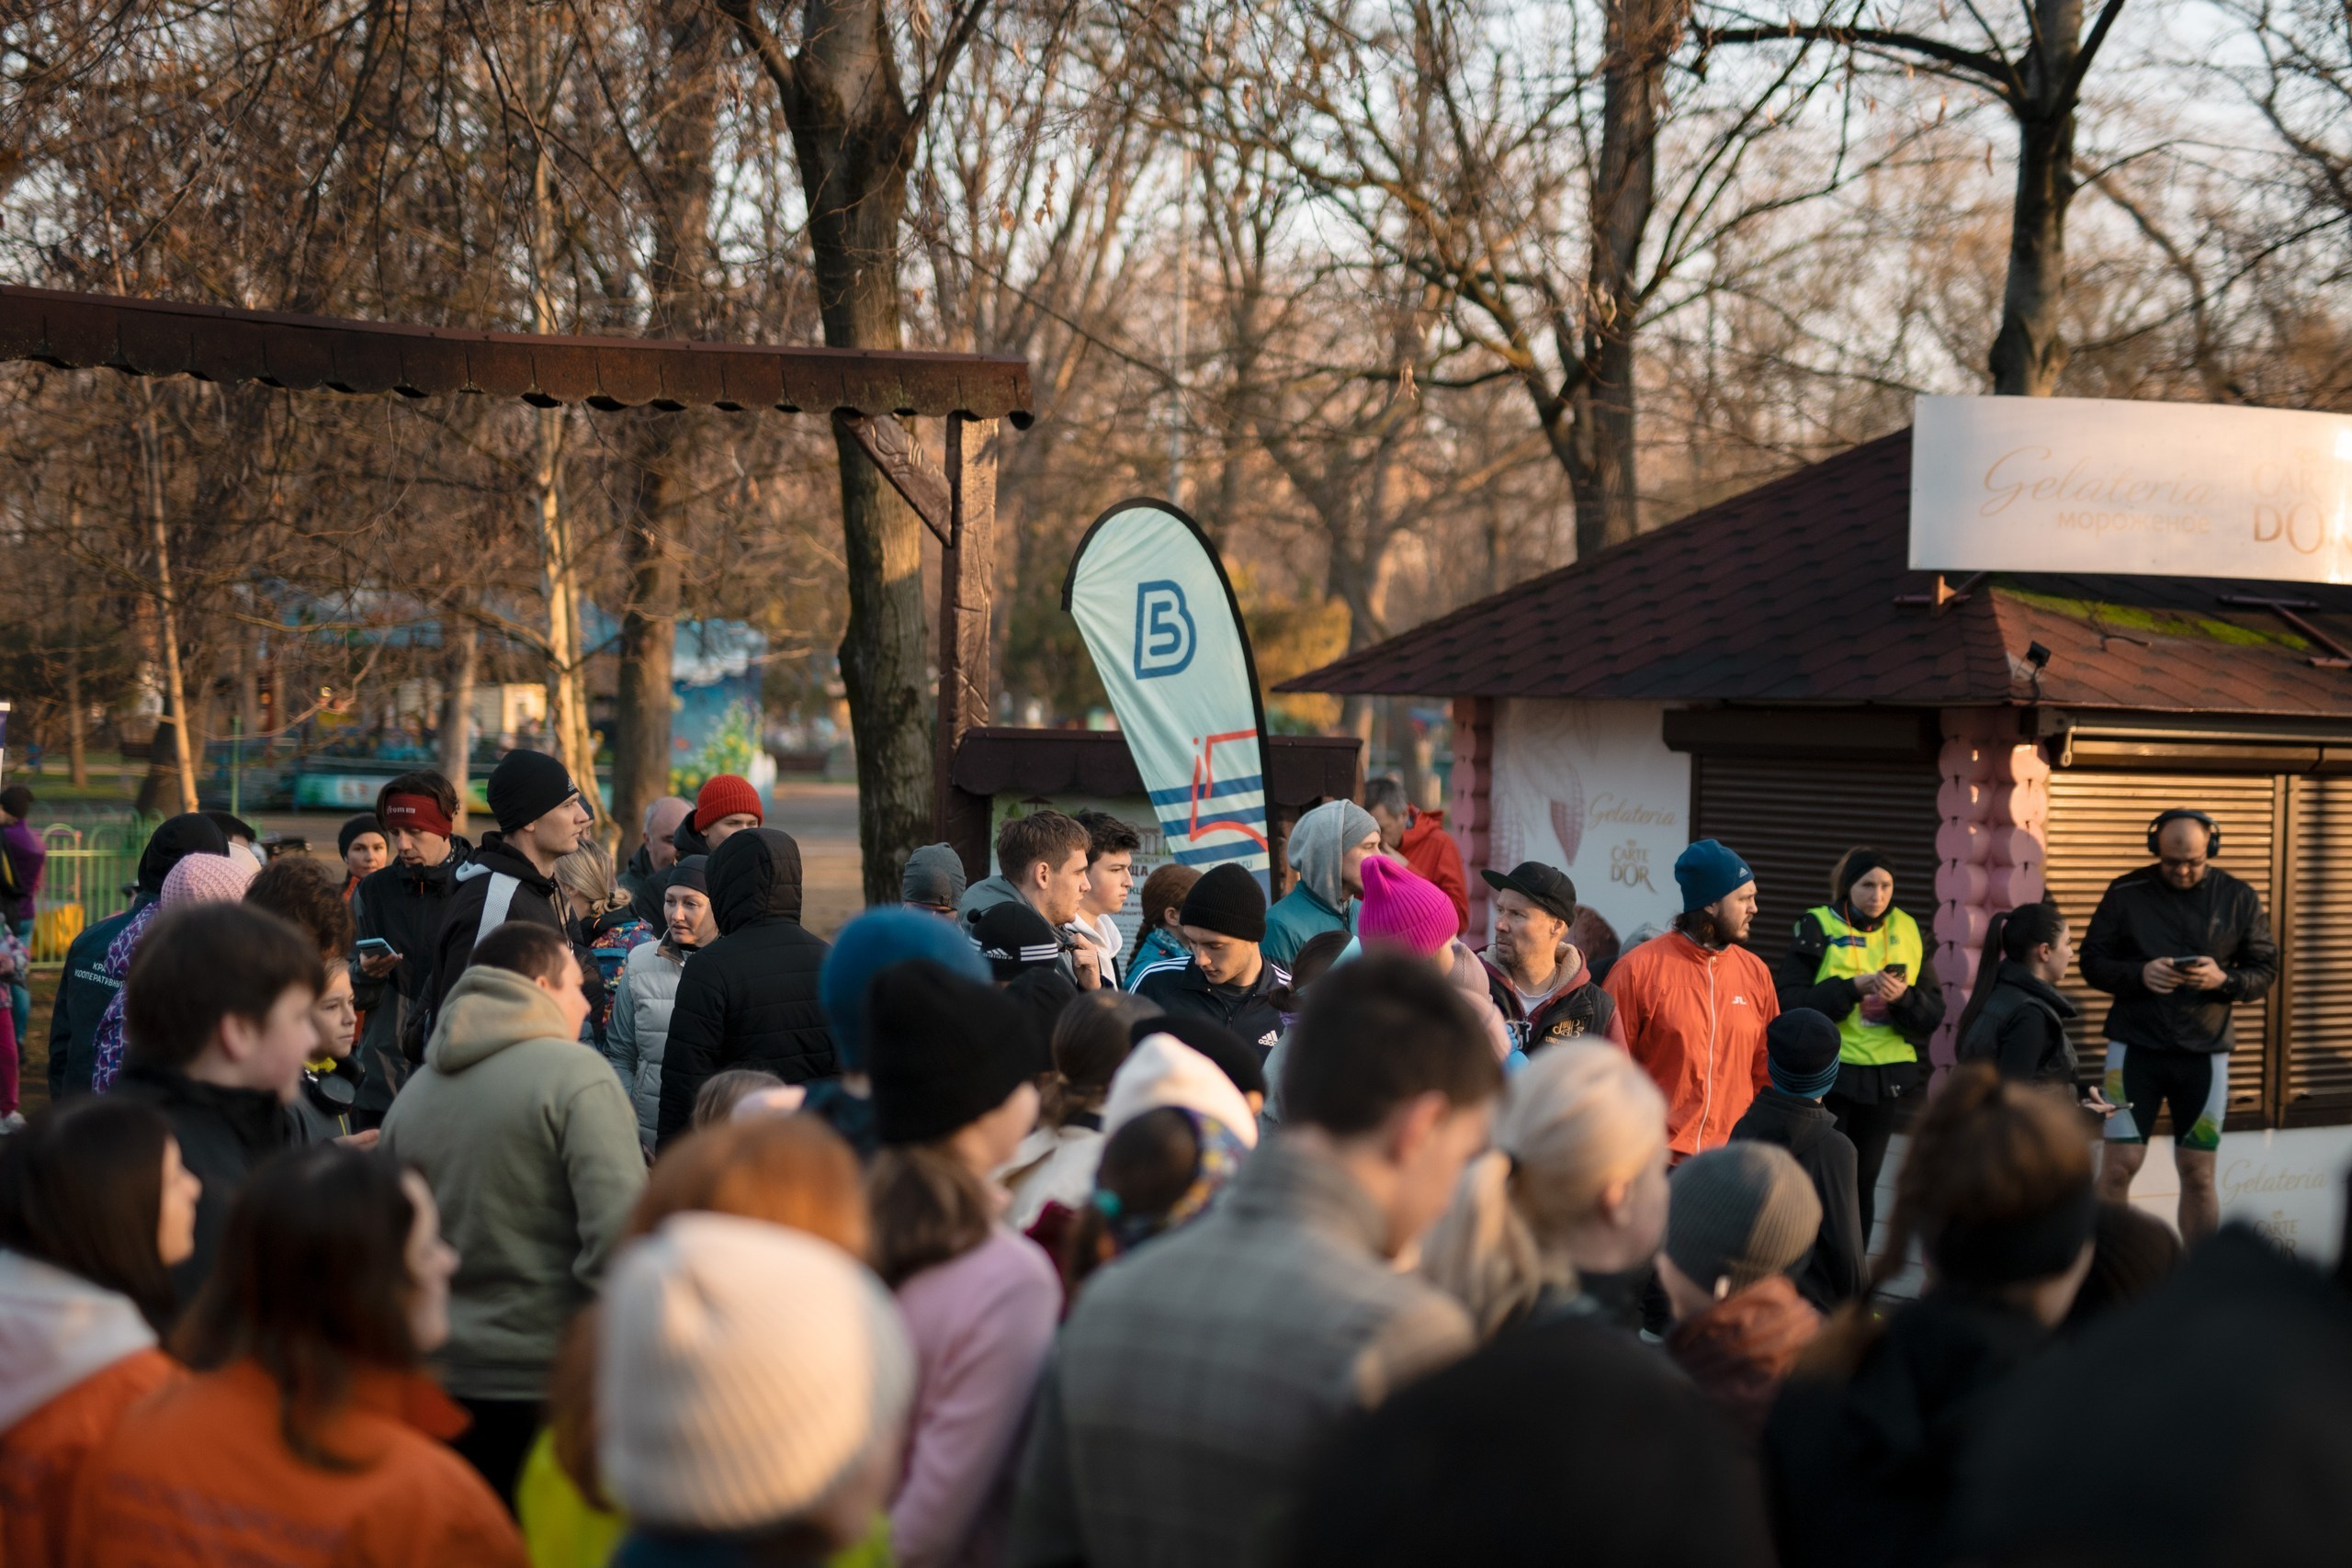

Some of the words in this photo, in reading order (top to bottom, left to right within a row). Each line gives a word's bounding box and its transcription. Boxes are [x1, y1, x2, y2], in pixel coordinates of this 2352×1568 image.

[1979, 444, 2220, 517] Gelateria
[2057, 509, 2211, 537] мороженое
[1588, 792, 1677, 830] Gelateria
[1611, 845, 1650, 863] CARTE
[2221, 1157, 2328, 1207] Gelateria
